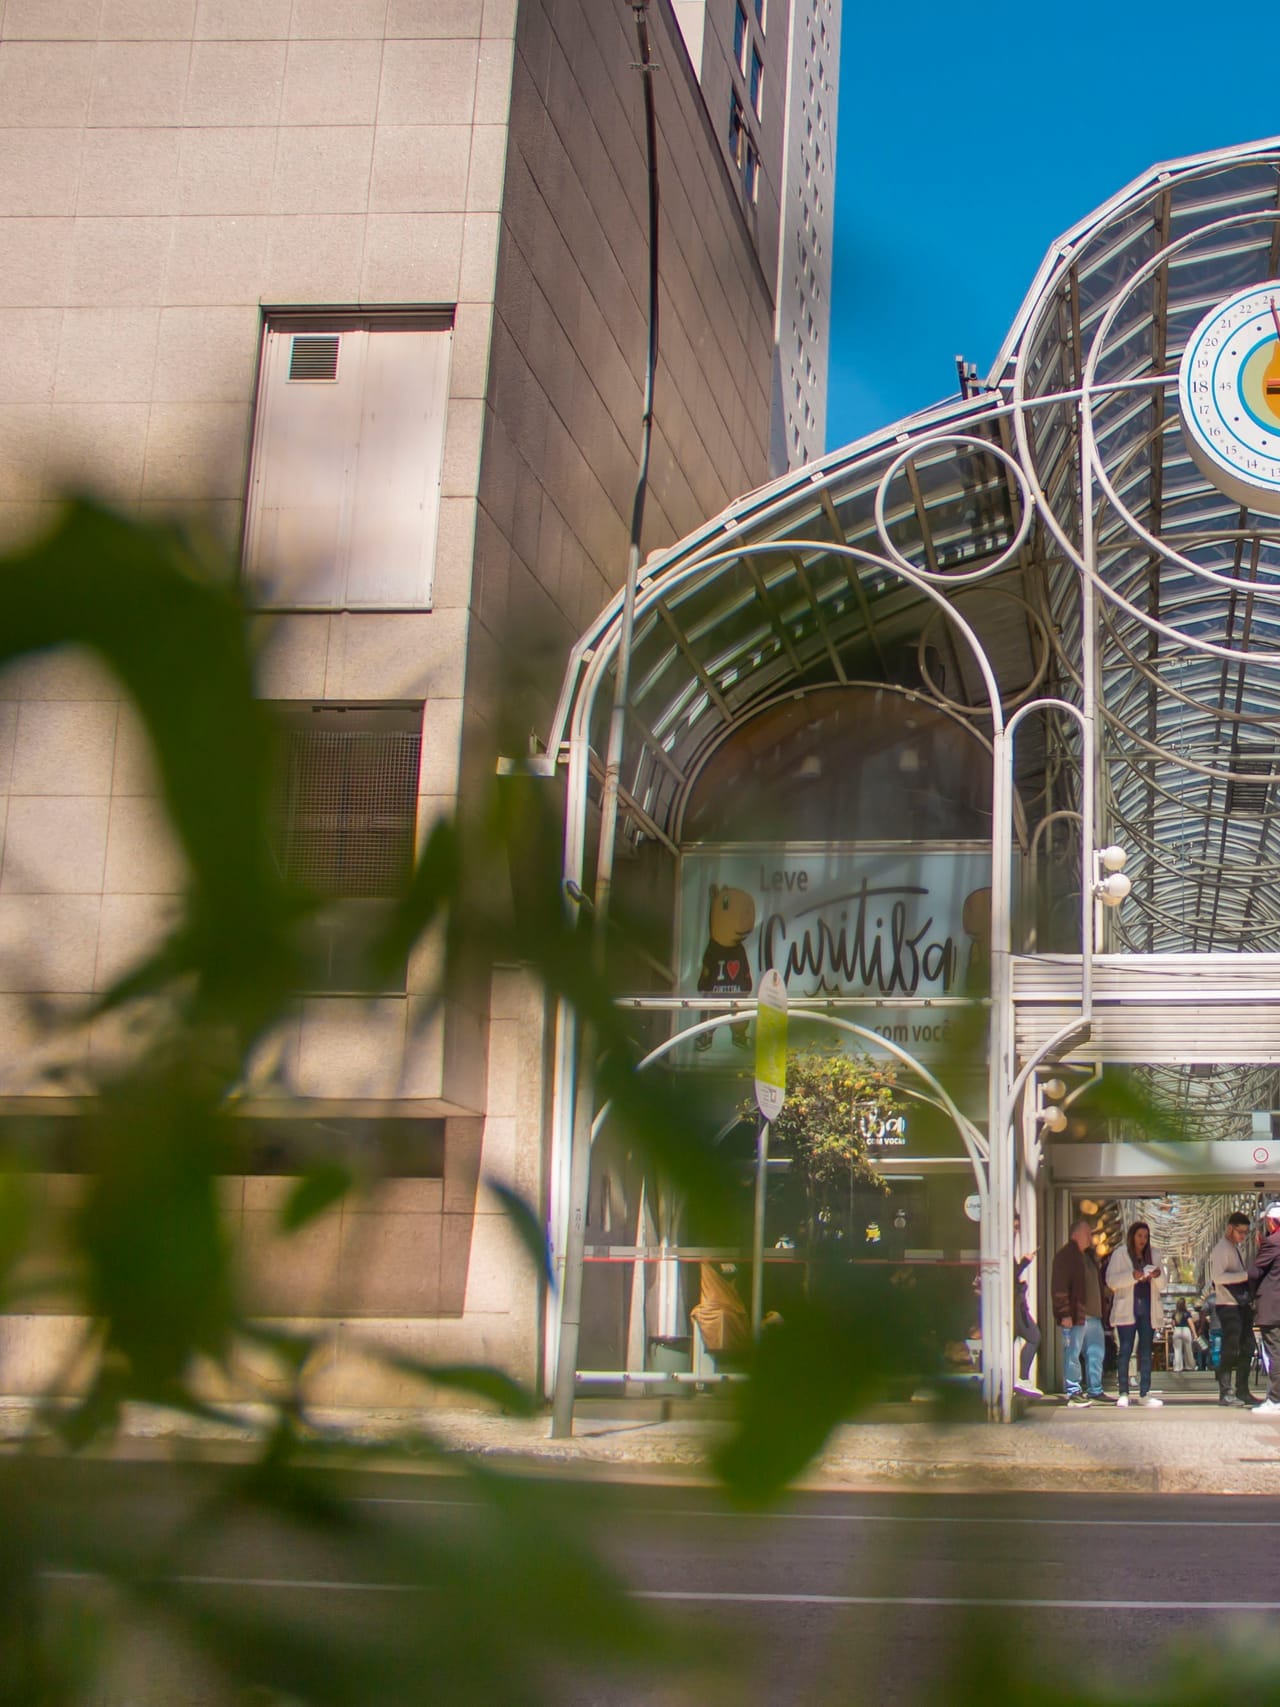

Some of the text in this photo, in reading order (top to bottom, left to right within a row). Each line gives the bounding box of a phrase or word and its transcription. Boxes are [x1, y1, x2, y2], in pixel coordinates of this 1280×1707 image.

[1240, 305, 1252, 313] 22
[1221, 320, 1231, 328] 21
[1205, 338, 1218, 346] 20
[1197, 360, 1208, 368] 19
[1192, 381, 1208, 393] 18
[1219, 382, 1231, 391] 45
[1199, 405, 1209, 414] 17
[1209, 427, 1220, 436] 16
[1226, 445, 1237, 454] 15
[1247, 460, 1257, 469] 14
[760, 865, 808, 892] Leve
[757, 877, 957, 997] Curitiba
[717, 960, 725, 980] I
